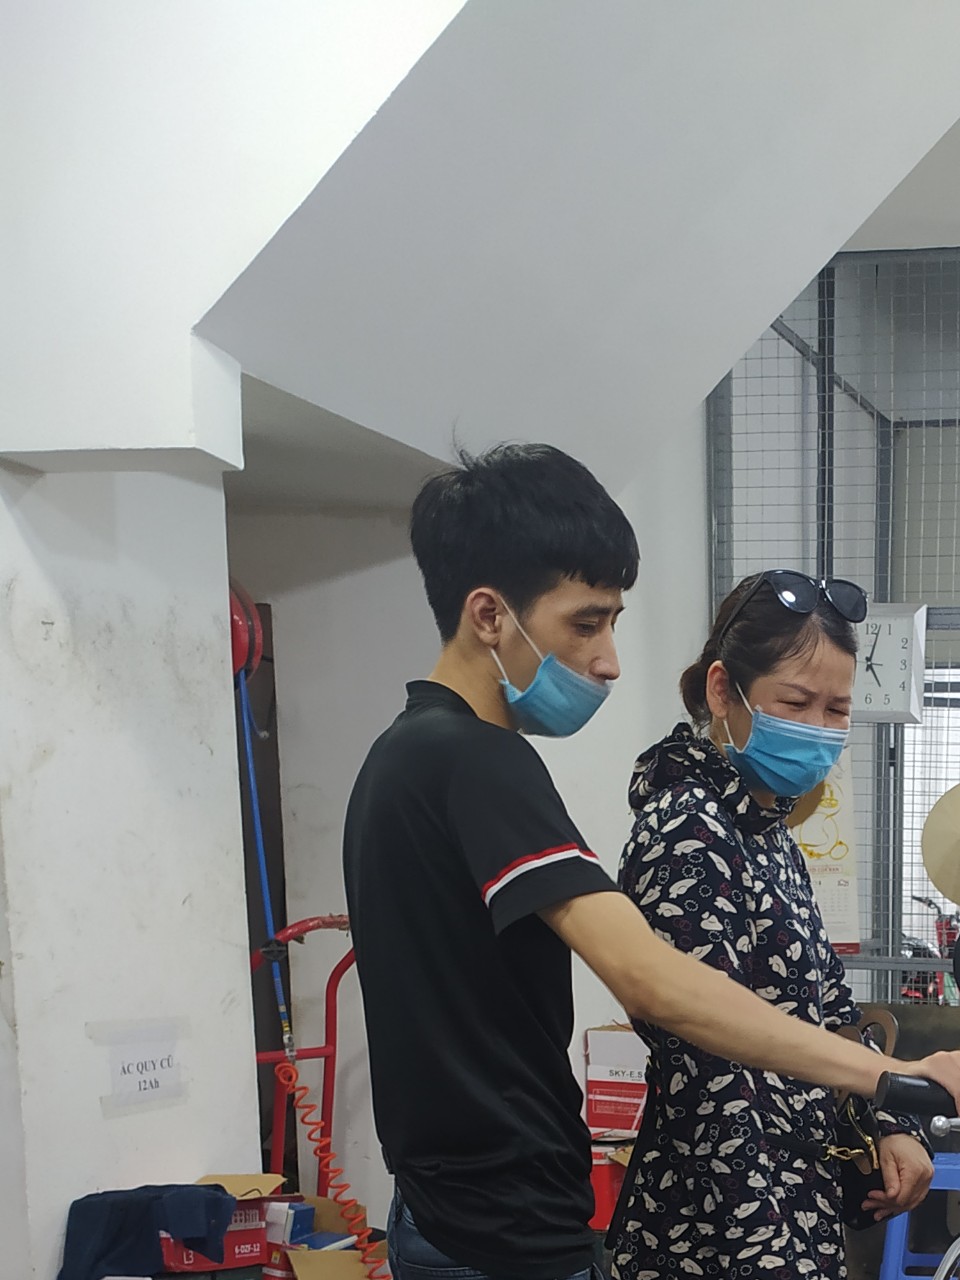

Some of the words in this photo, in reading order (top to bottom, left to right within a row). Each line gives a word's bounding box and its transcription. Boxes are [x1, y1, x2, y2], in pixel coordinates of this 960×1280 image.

[865, 624, 878, 634] 12
[888, 624, 892, 635] 1
[902, 638, 908, 649] 2
[900, 660, 907, 670] 3
[899, 681, 906, 691] 4
[865, 693, 872, 704] 6
[884, 694, 890, 705] 5
[137, 1059, 157, 1074] QUY
[160, 1054, 173, 1069] CŨ
[609, 1069, 643, 1078] SKY-E.S
[138, 1078, 159, 1091] 12Ah
